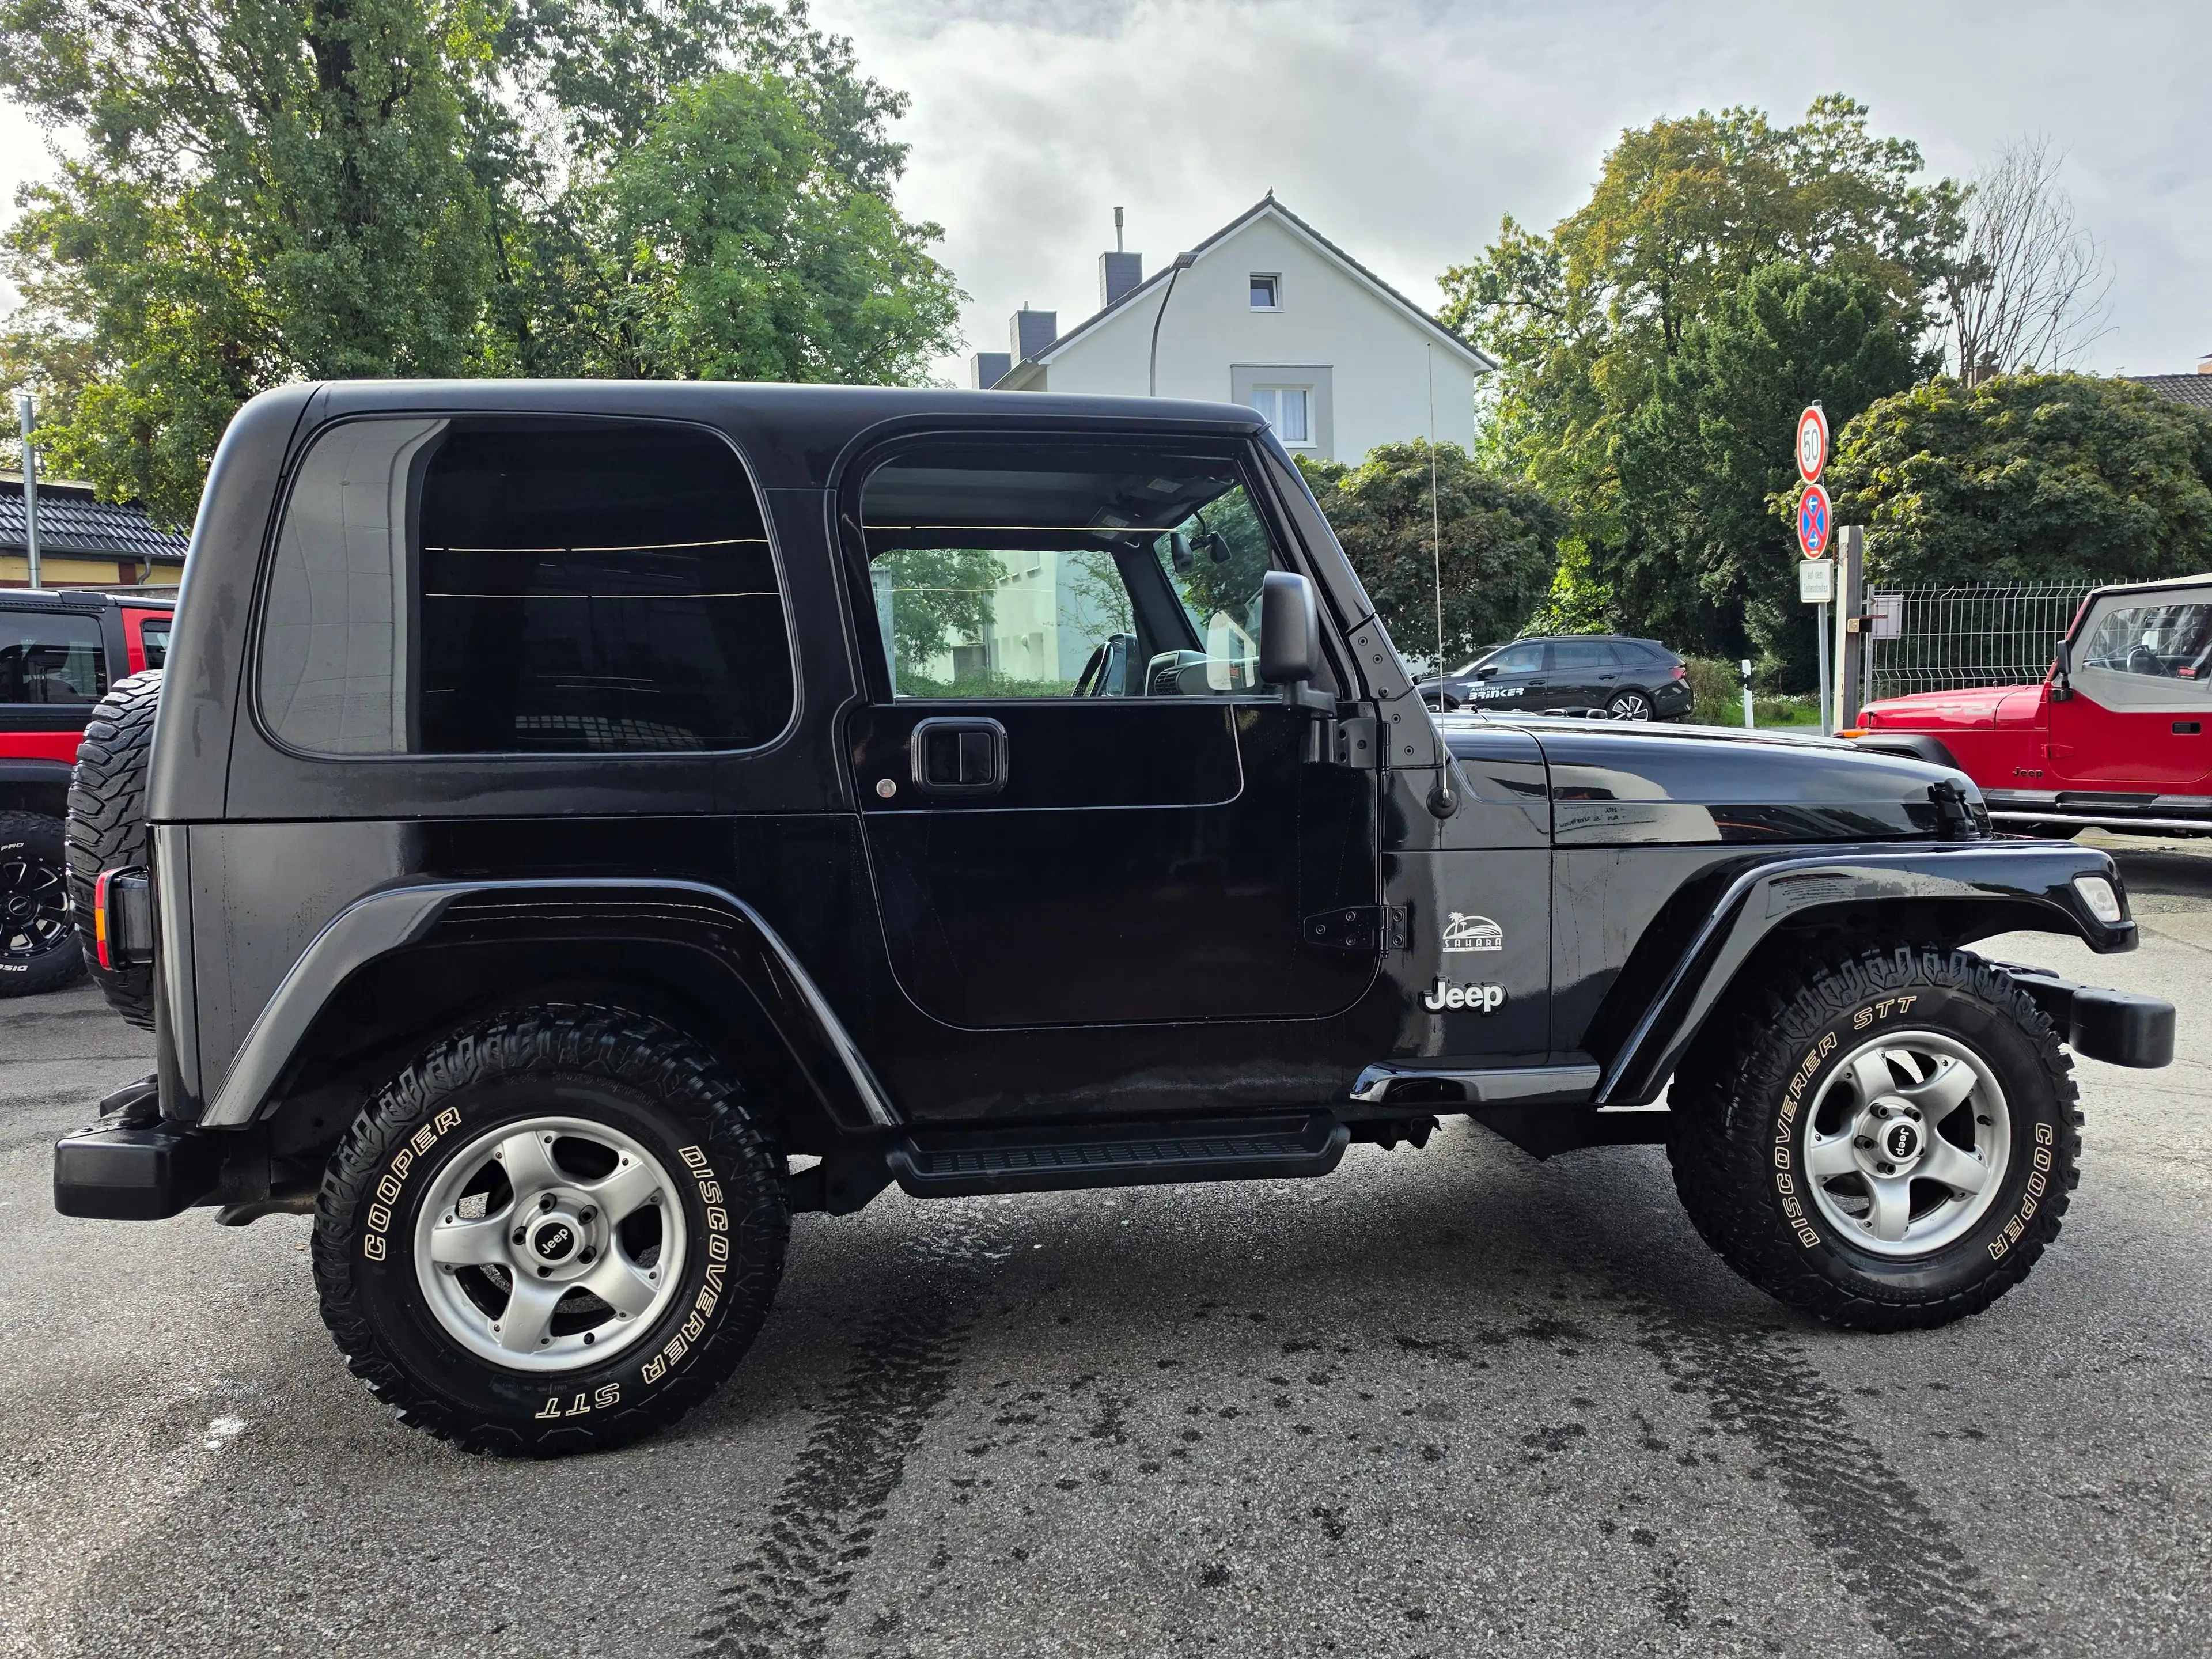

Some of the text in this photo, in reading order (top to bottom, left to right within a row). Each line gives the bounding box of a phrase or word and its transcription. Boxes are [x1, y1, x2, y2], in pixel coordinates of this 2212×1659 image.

[1804, 428, 1819, 462] 50
[1468, 687, 1525, 700] BRINKER
[2012, 766, 2043, 780] Jeep
[1, 842, 24, 851] PRO
[1444, 938, 1502, 948] SAHARA
[1425, 981, 1503, 1013] Jeep
[1774, 995, 1918, 1248] DISCOVERER STT
[1895, 1127, 1910, 1156] Jeep
[363, 1106, 463, 1262] COOPER
[1988, 1122, 2052, 1262] COOPER
[541, 1228, 569, 1255] Jeep
[640, 1145, 733, 1385] DISCOVERER
[534, 1382, 621, 1419] STT
